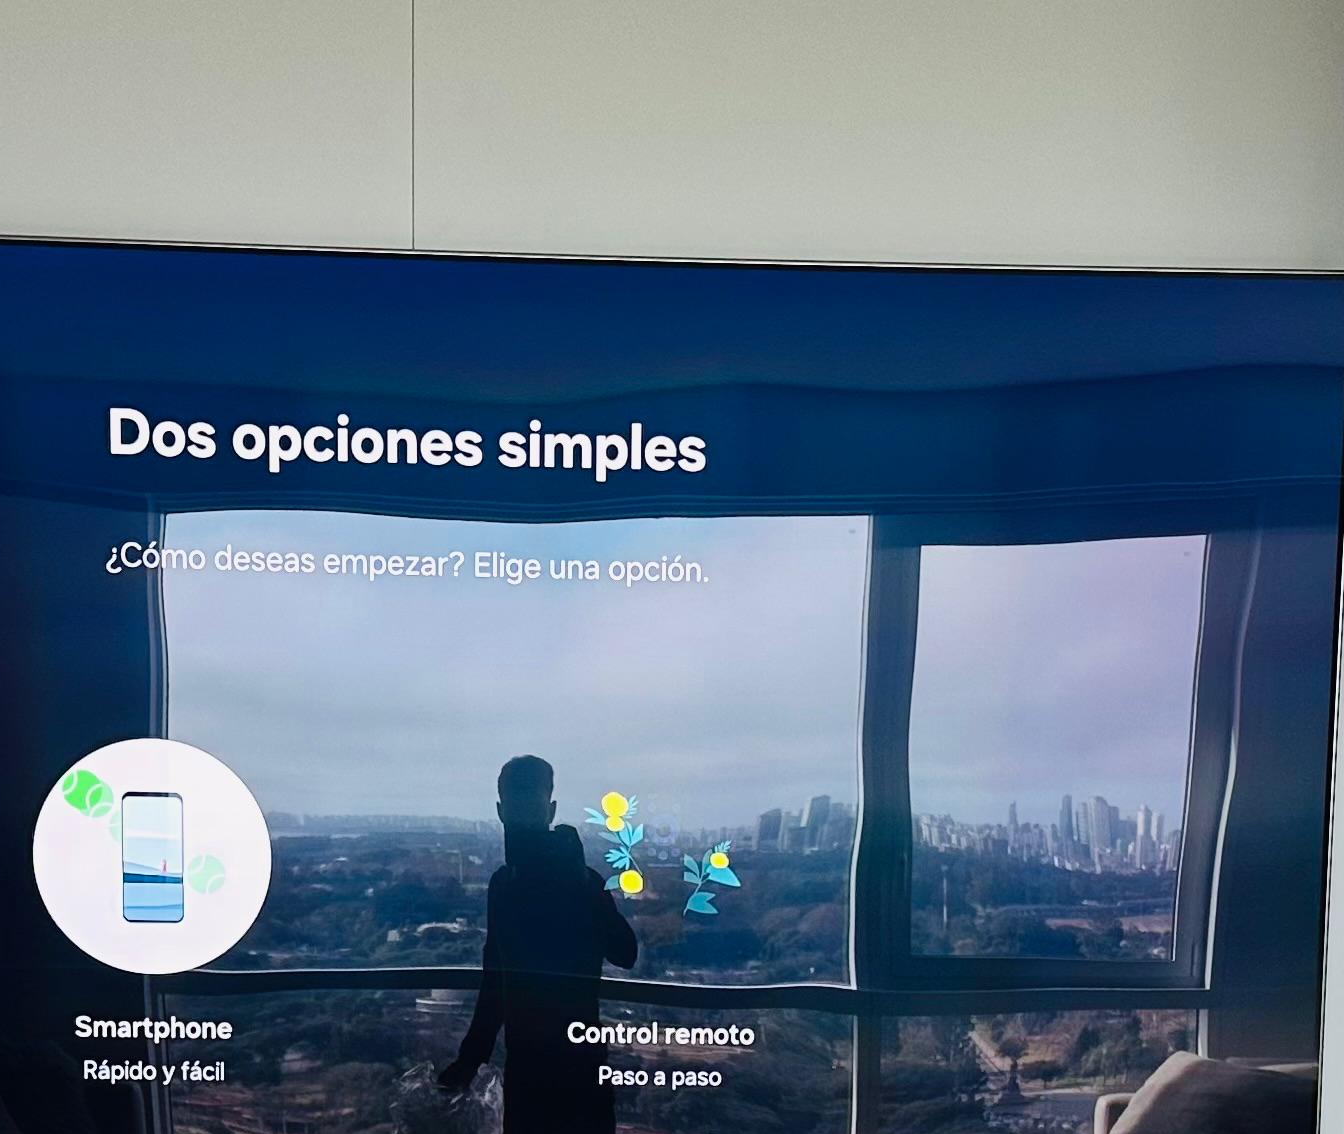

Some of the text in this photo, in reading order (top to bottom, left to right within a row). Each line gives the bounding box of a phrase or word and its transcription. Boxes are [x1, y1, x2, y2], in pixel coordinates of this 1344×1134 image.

[109, 407, 707, 482] Dos opciones simples
[106, 541, 710, 585] ¿Cómo deseas empezar? Elige una opción.
[75, 1015, 233, 1044] Smartphone
[567, 1022, 755, 1045] Control remoto
[83, 1059, 225, 1085] Rápido y fácil
[598, 1066, 722, 1090] Paso a paso
